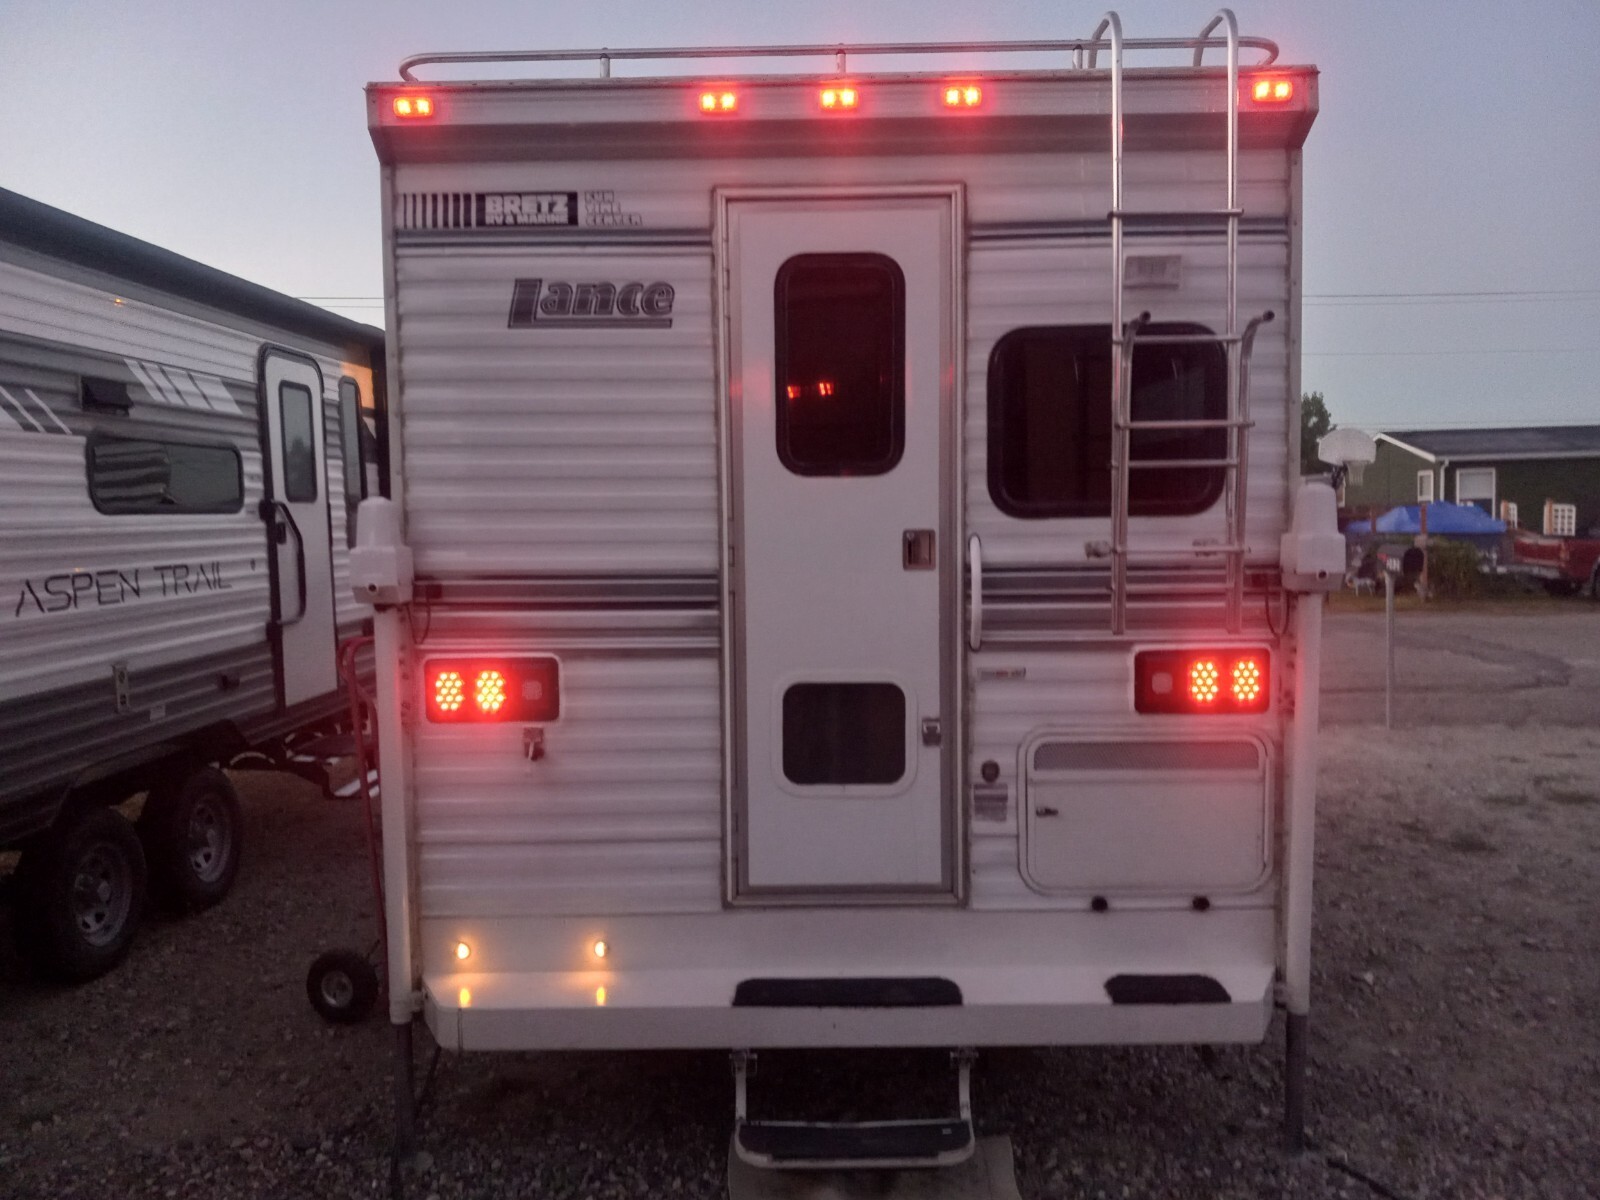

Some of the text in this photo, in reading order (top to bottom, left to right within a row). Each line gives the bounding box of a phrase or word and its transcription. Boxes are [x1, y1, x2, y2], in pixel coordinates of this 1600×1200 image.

[485, 194, 568, 214] BRETZ
[508, 279, 675, 329] Lance
[15, 561, 232, 617] ASPEN TRAIL
